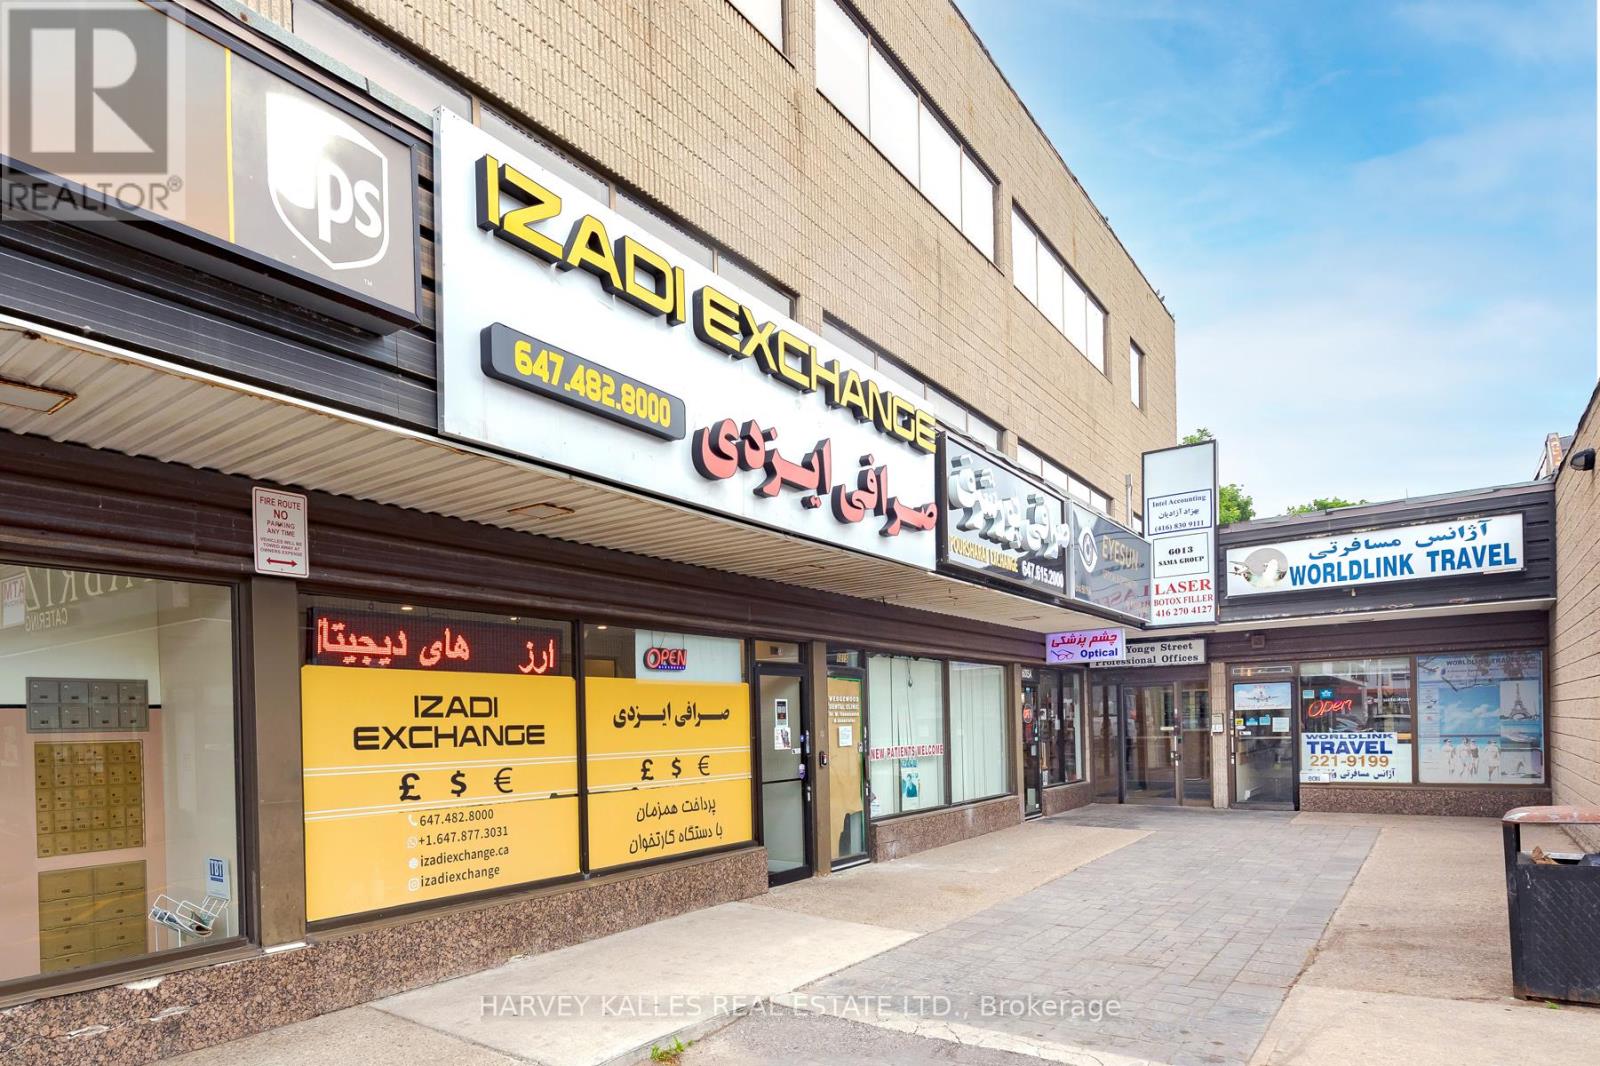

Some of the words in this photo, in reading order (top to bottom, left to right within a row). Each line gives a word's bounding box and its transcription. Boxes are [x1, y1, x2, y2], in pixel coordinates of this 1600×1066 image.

[476, 154, 686, 325] IZADI
[693, 285, 936, 454] EXCHANGE
[514, 339, 671, 428] 647.482.8000
[692, 417, 831, 508] ایزدی
[259, 496, 276, 507] FIRE
[277, 499, 301, 511] ROUTE
[831, 454, 938, 536] صرافی
[1169, 495, 1207, 505] Accounting
[266, 519, 295, 530] PARKING
[273, 510, 288, 520] NO
[1154, 524, 1172, 532] (416)
[1309, 537, 1402, 560] مسافرتی
[1158, 558, 1177, 567] SAMA
[1179, 556, 1205, 565] GROUP
[1290, 553, 1414, 586] WORLDLINK
[1427, 543, 1516, 573] TRAVEL
[1155, 579, 1212, 596] LASER
[1153, 597, 1181, 607] BOTOX
[1183, 594, 1213, 604] FILLER
[1156, 608, 1171, 618] 416
[1173, 607, 1189, 616] 270
[1191, 605, 1212, 614] 4127
[419, 627, 470, 667] های
[1051, 633, 1087, 648] پزشکی
[1088, 631, 1118, 648] چشم
[1126, 645, 1155, 654] Yonge
[1160, 642, 1193, 651] Street
[646, 648, 688, 669] OPEN
[1080, 648, 1118, 659] Optical
[1161, 654, 1199, 663] Offices
[414, 695, 498, 718] IZADI
[613, 701, 671, 728] ایزدی
[674, 701, 730, 728] صرافی
[353, 725, 545, 751] EXCHANGE
[869, 748, 884, 760] NEW
[887, 745, 915, 759] PATIENTS
[917, 744, 944, 757] WELCOME
[1306, 741, 1393, 755] TRAVEL
[1310, 755, 1389, 767] 221-9199
[636, 802, 678, 823] همزمان
[681, 796, 716, 816] پرداخت
[419, 808, 494, 827] 647.482.8000
[418, 826, 509, 846] +1.647.877.3031
[629, 829, 676, 855] کارتخوان
[678, 826, 713, 842] دستگاه
[420, 846, 509, 868] izadiexchange.ca
[421, 866, 501, 888] izadiexchange
